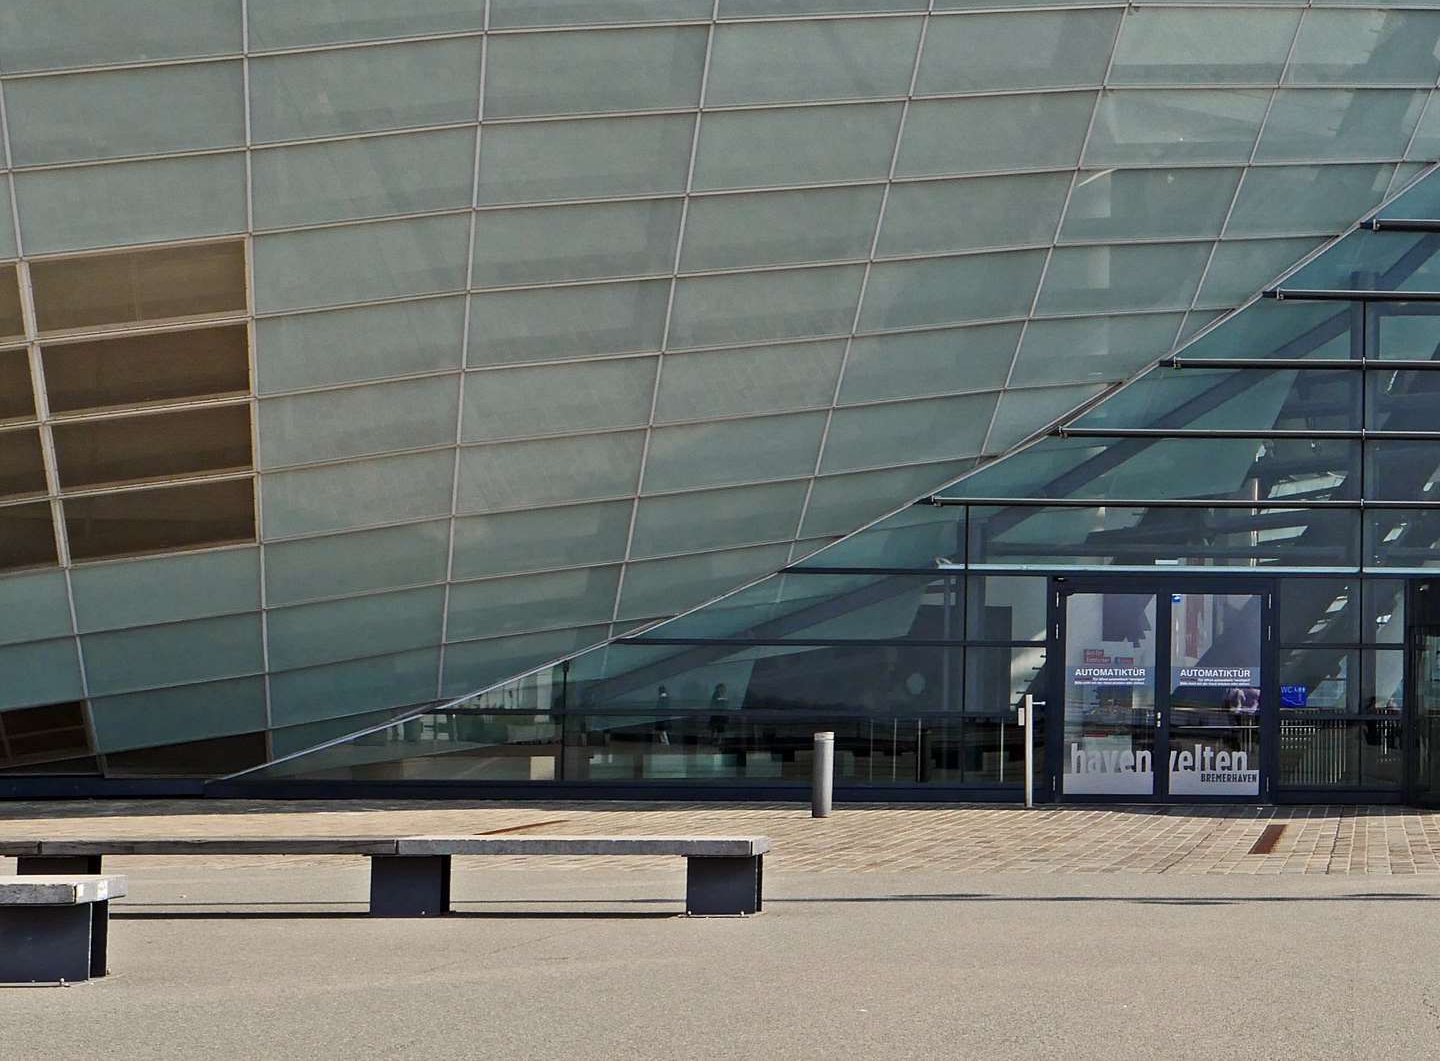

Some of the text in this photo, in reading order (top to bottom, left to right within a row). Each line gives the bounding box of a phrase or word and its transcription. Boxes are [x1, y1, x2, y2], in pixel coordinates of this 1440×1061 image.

[1075, 667, 1146, 676] AUTOMATIKTÜR
[1180, 668, 1250, 677] AUTOMATIKTÜR
[1071, 743, 1151, 773] haven
[1200, 773, 1257, 783] BREMERHAVEN
